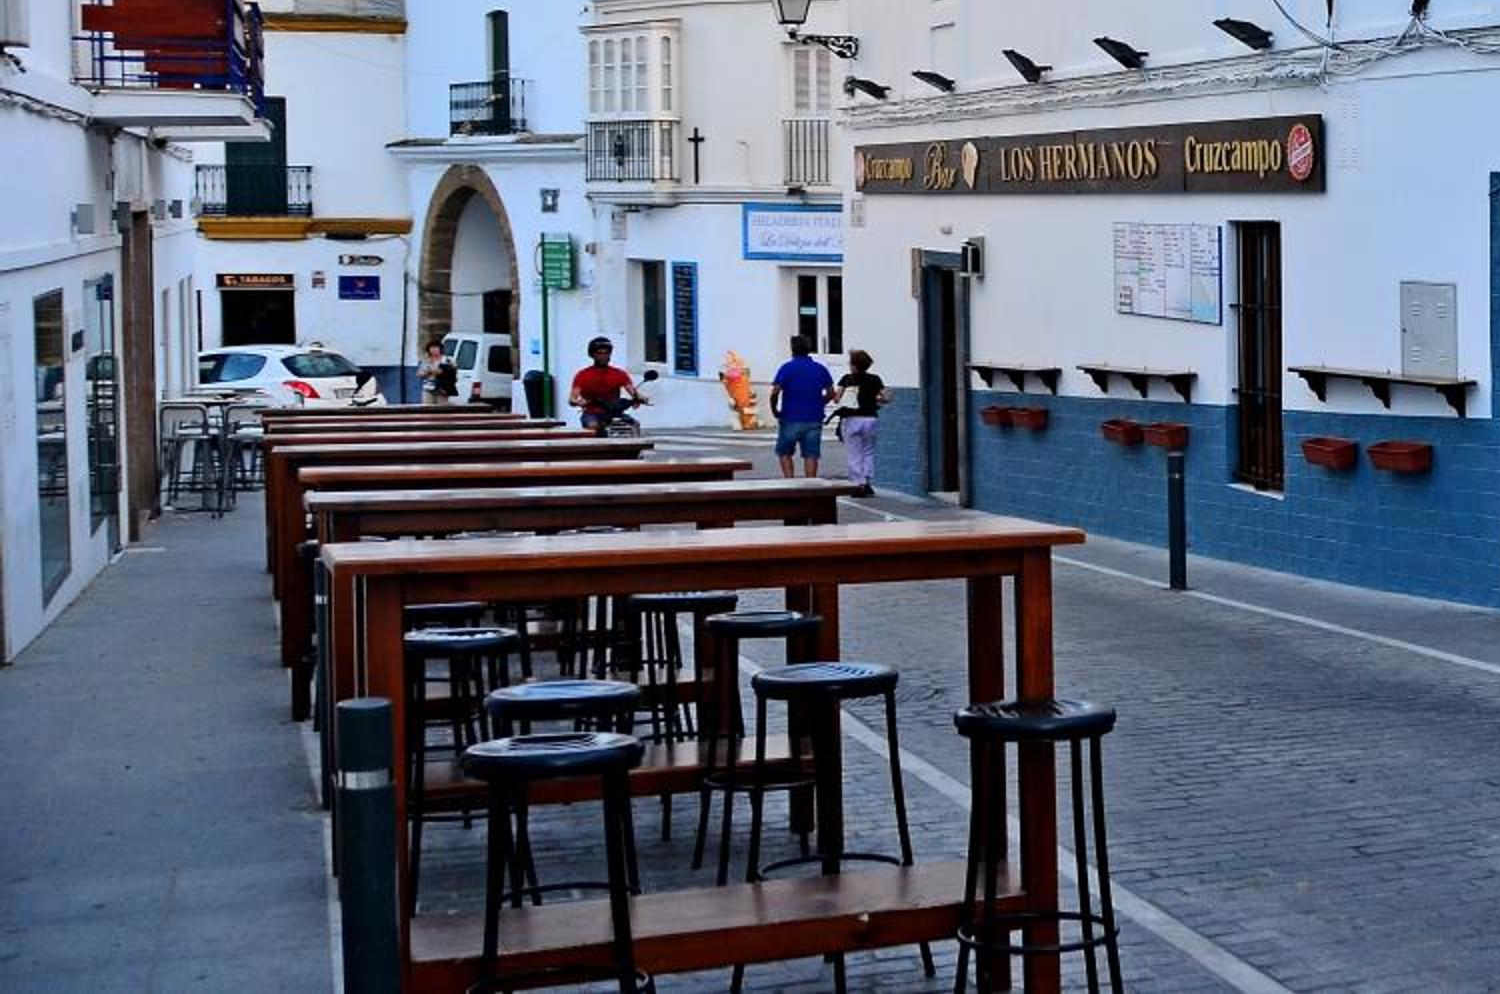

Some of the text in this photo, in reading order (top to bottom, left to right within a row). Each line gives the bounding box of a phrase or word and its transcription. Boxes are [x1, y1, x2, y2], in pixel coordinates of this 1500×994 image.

[1001, 146, 1034, 181] LOS
[1039, 140, 1158, 180] HERMANOS
[1184, 135, 1282, 179] Cruzcampo
